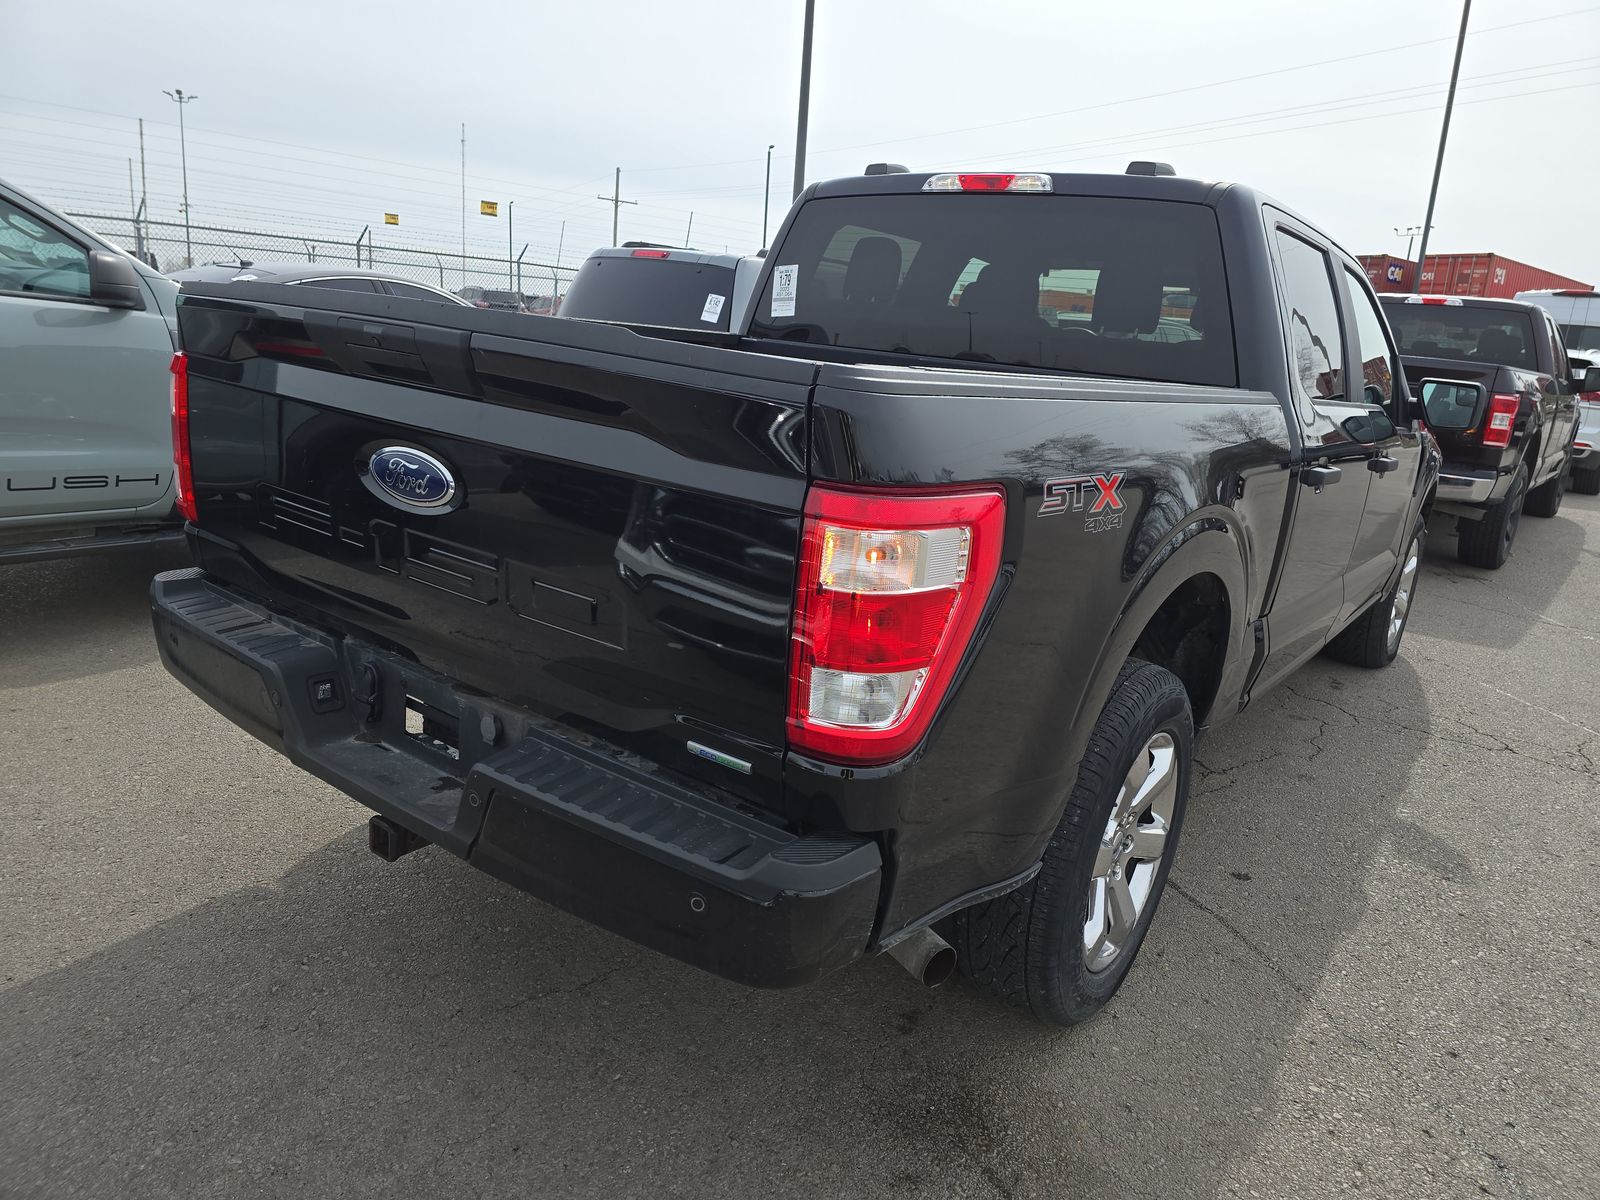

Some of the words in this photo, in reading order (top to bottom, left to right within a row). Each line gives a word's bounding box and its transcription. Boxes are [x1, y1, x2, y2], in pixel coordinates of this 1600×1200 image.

[7, 473, 160, 491] USH
[384, 457, 430, 496] Ford
[1037, 471, 1128, 520] STX
